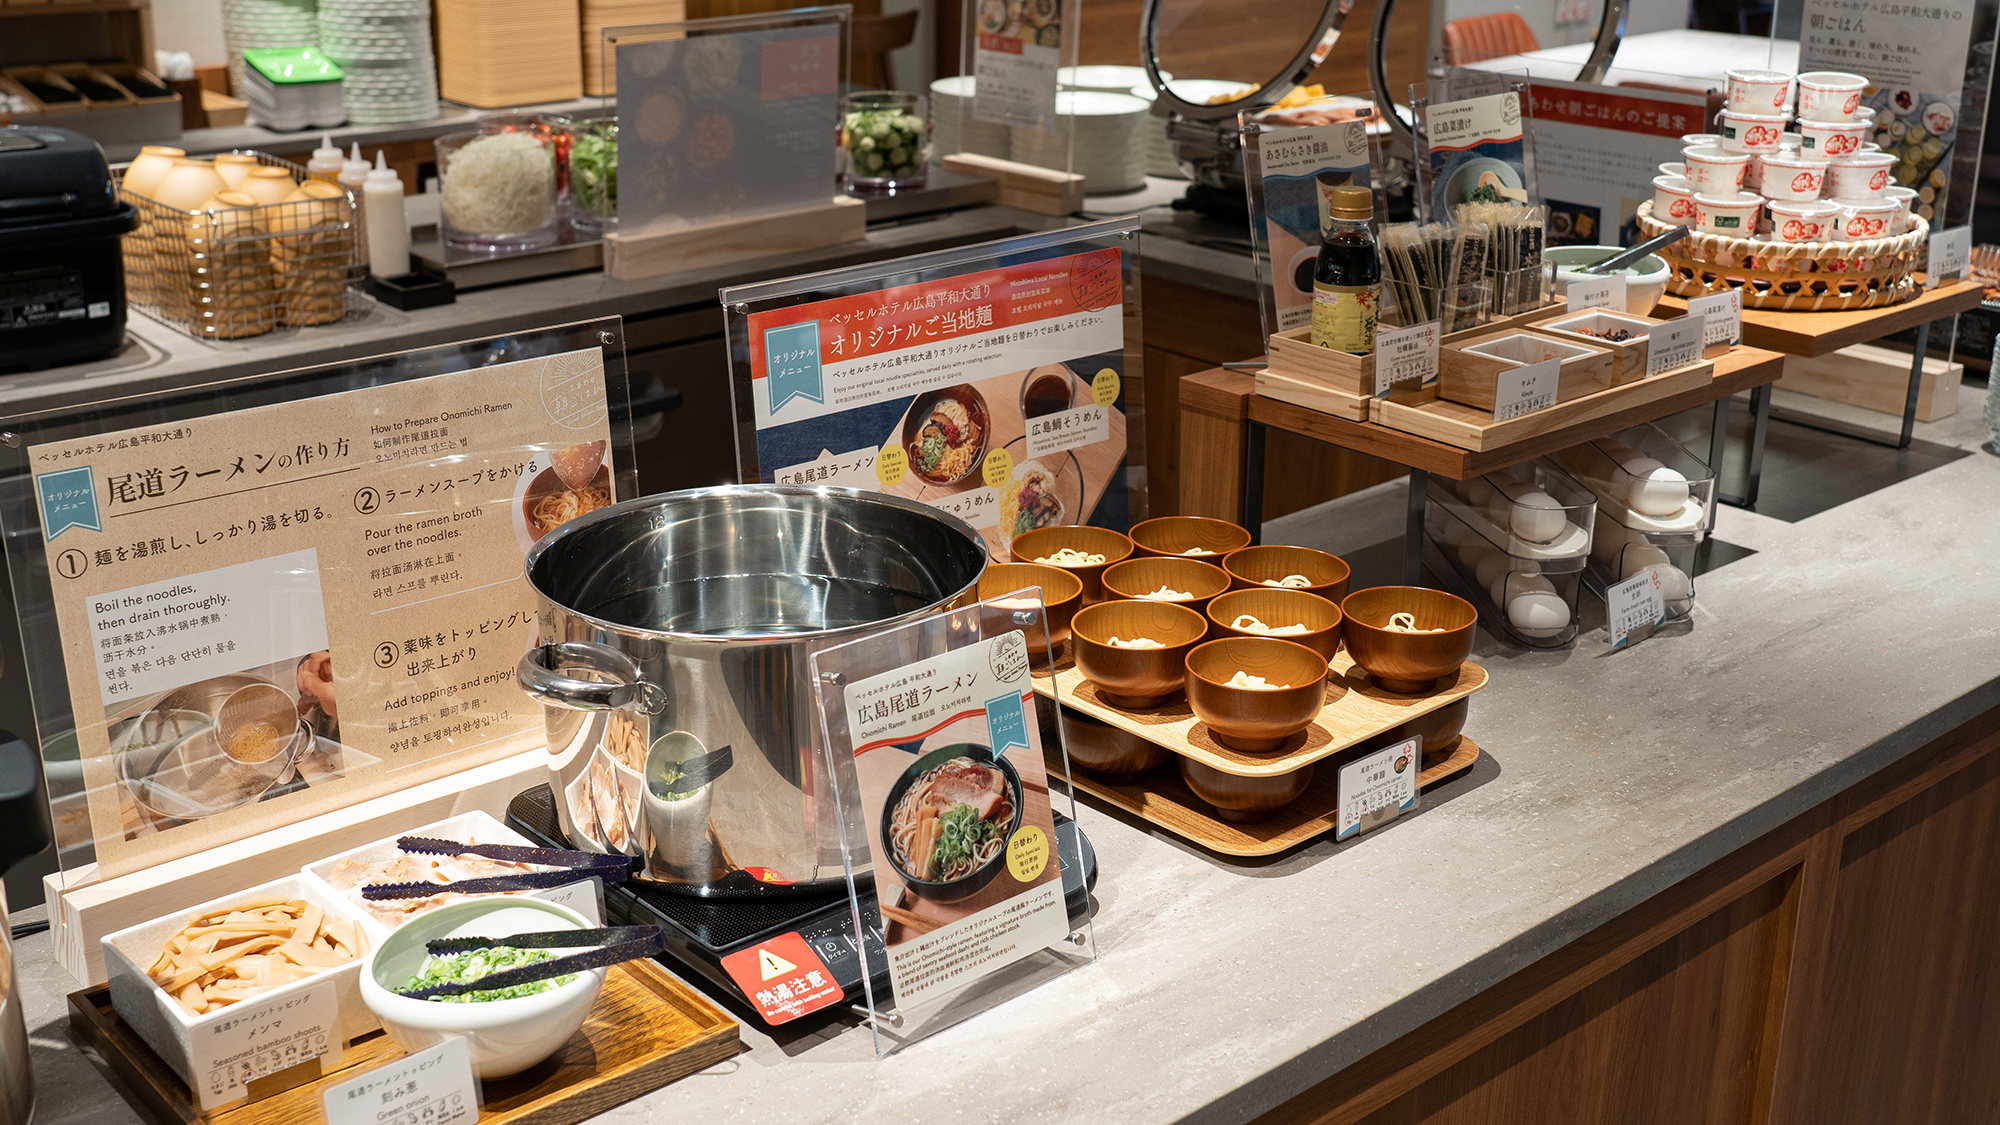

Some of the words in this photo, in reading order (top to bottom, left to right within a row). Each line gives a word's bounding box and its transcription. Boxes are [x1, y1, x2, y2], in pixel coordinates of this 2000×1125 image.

[1811, 14, 1866, 33] 朝ごはん
[1434, 118, 1471, 134] 広島菜漬け
[1521, 97, 1686, 131] あわせ朝ごはんのご提案
[1266, 142, 1328, 161] あさむらさき醤油
[1035, 275, 1048, 283] Local
[829, 284, 991, 325] ベッセルホテル広島平和大通り
[830, 304, 993, 355] オリジナルご当地麺
[773, 349, 816, 364] オリジナル
[779, 365, 811, 379] メニュー
[834, 384, 847, 394] Enjoy
[856, 379, 873, 389] original
[874, 377, 885, 385] local
[886, 375, 901, 383] noodle
[926, 365, 939, 374] served
[940, 363, 952, 372] daily
[1522, 377, 1536, 387] キムチ
[371, 422, 392, 434] How
[393, 420, 403, 431] to
[404, 414, 438, 429] Prepare
[441, 406, 483, 421] Onomichi
[484, 401, 512, 413] Ramen
[1032, 410, 1102, 436] 広島鯛そうめん
[39, 427, 193, 462] ベッセルホテル広島平和大通り
[373, 427, 449, 450] 如何制作尾道拉面
[107, 438, 350, 507] 尾道ラーメンの作り方
[384, 460, 538, 503] ラーメンスープをかける
[781, 455, 875, 484] 広島尾道ラーメン
[47, 487, 90, 503] オリジナル
[53, 501, 87, 513] メニュー
[94, 506, 333, 567] 麺を湯煎し、しっかり湯を切る。
[365, 528, 391, 541] Pour
[395, 523, 413, 534] the
[416, 516, 450, 530] ramen
[453, 506, 483, 523] broth
[367, 544, 391, 557] over
[395, 539, 413, 551] the
[416, 529, 462, 546] noodles.
[370, 552, 463, 581] 将拉面汤淋在上面。
[95, 596, 120, 614] Boil
[123, 593, 143, 608] the
[146, 584, 197, 603] noodles,
[372, 586, 393, 599] 라면
[396, 579, 427, 594] 스프를
[430, 569, 463, 586] 뿌린다.
[98, 616, 126, 631] then
[129, 609, 160, 624] drain
[164, 593, 231, 616] thoroughly.
[403, 609, 538, 655] 薬味をトッピングし
[105, 666, 127, 680] 면을
[156, 654, 177, 667] 다음
[181, 645, 212, 662] 단단히
[406, 646, 477, 677] 出来上がり
[384, 698, 408, 712] Add
[410, 685, 458, 704] toppings
[461, 677, 480, 691] and
[483, 666, 516, 685] enjoy!
[855, 679, 908, 699] ベッセルホテル広島
[909, 668, 937, 682] 平和大通り
[858, 672, 978, 726] 広島尾道ラーメン
[861, 725, 887, 739] Onomichi
[889, 720, 907, 730] Ramen
[911, 708, 935, 723] 尾道拉面
[992, 710, 1021, 725] オリジナル
[997, 722, 1019, 734] メニュー
[390, 737, 419, 753] 양념을
[1366, 770, 1385, 784] 中華麺
[1014, 834, 1037, 849] 日替わり
[896, 964, 907, 972] This
[921, 942, 957, 961] Onomichi-style
[974, 927, 995, 940] featuring
[999, 916, 1019, 929] signature
[1020, 911, 1032, 920] broth
[1032, 906, 1044, 914] made
[1045, 900, 1056, 910] from
[902, 967, 915, 976] blend
[916, 964, 922, 972] of
[922, 961, 937, 971] savory
[938, 952, 957, 963] seafood
[957, 946, 970, 955] dashi
[980, 938, 989, 946] rich
[989, 930, 1007, 941] chicken
[1007, 924, 1020, 933] stock.
[756, 970, 827, 1008] 熱湯注意
[803, 992, 821, 1002] boiling
[822, 986, 835, 996] water
[214, 994, 311, 1034] 尾道ラーメントッピング
[248, 1020, 282, 1040] メンマ
[213, 1046, 254, 1068] Seasoned
[257, 1036, 291, 1055] bamboo
[294, 1025, 321, 1039] shoots
[348, 1054, 444, 1100] 尾道ラーメントッピング
[377, 1105, 404, 1121] Green
[406, 1094, 430, 1110] onion
